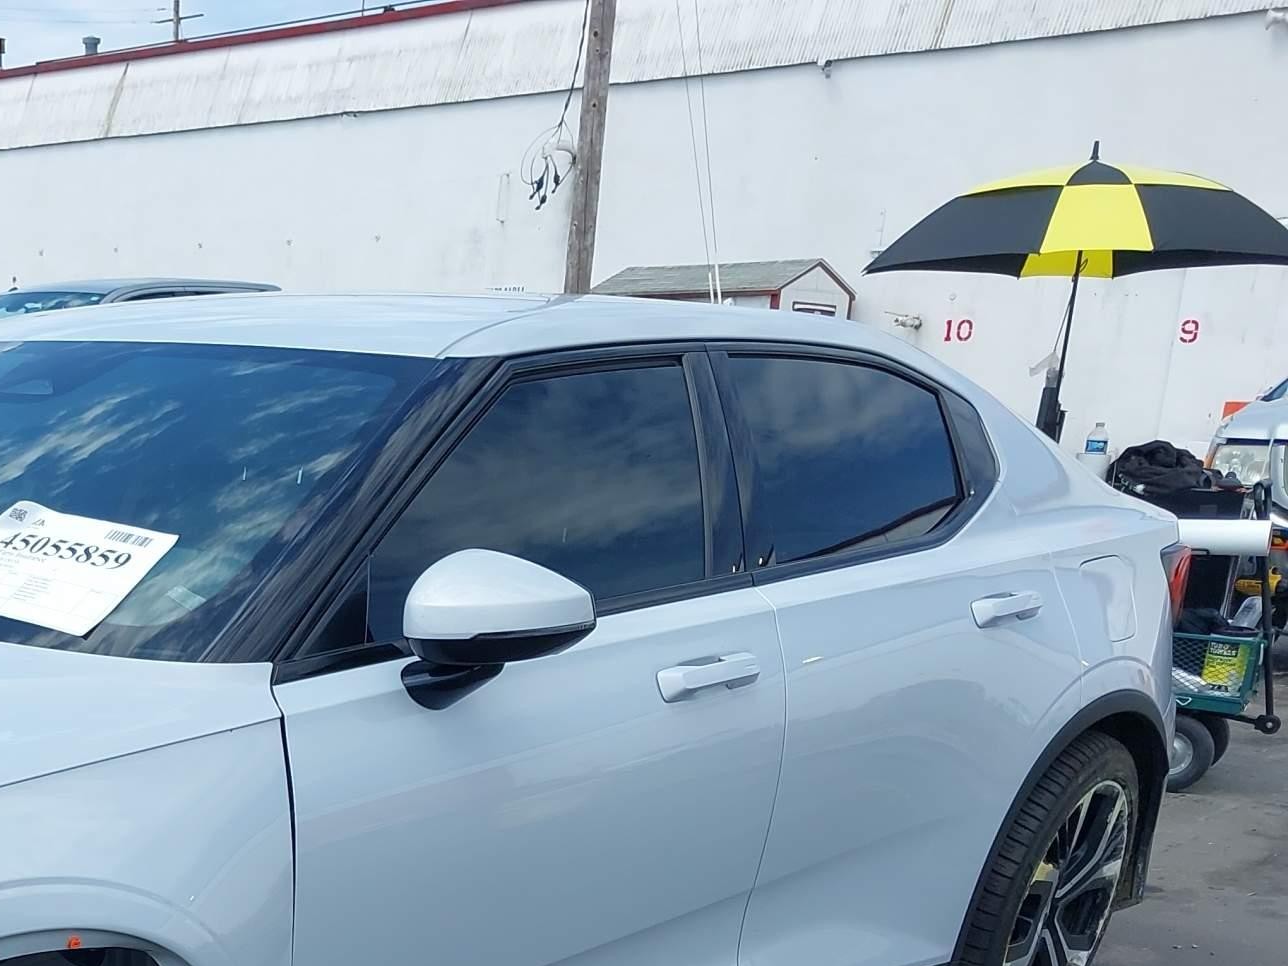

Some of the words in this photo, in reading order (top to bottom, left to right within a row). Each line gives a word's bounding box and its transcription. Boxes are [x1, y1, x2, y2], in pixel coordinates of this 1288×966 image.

[943, 319, 974, 342] 10
[1179, 319, 1200, 343] 9
[0, 532, 132, 569] 45055859
